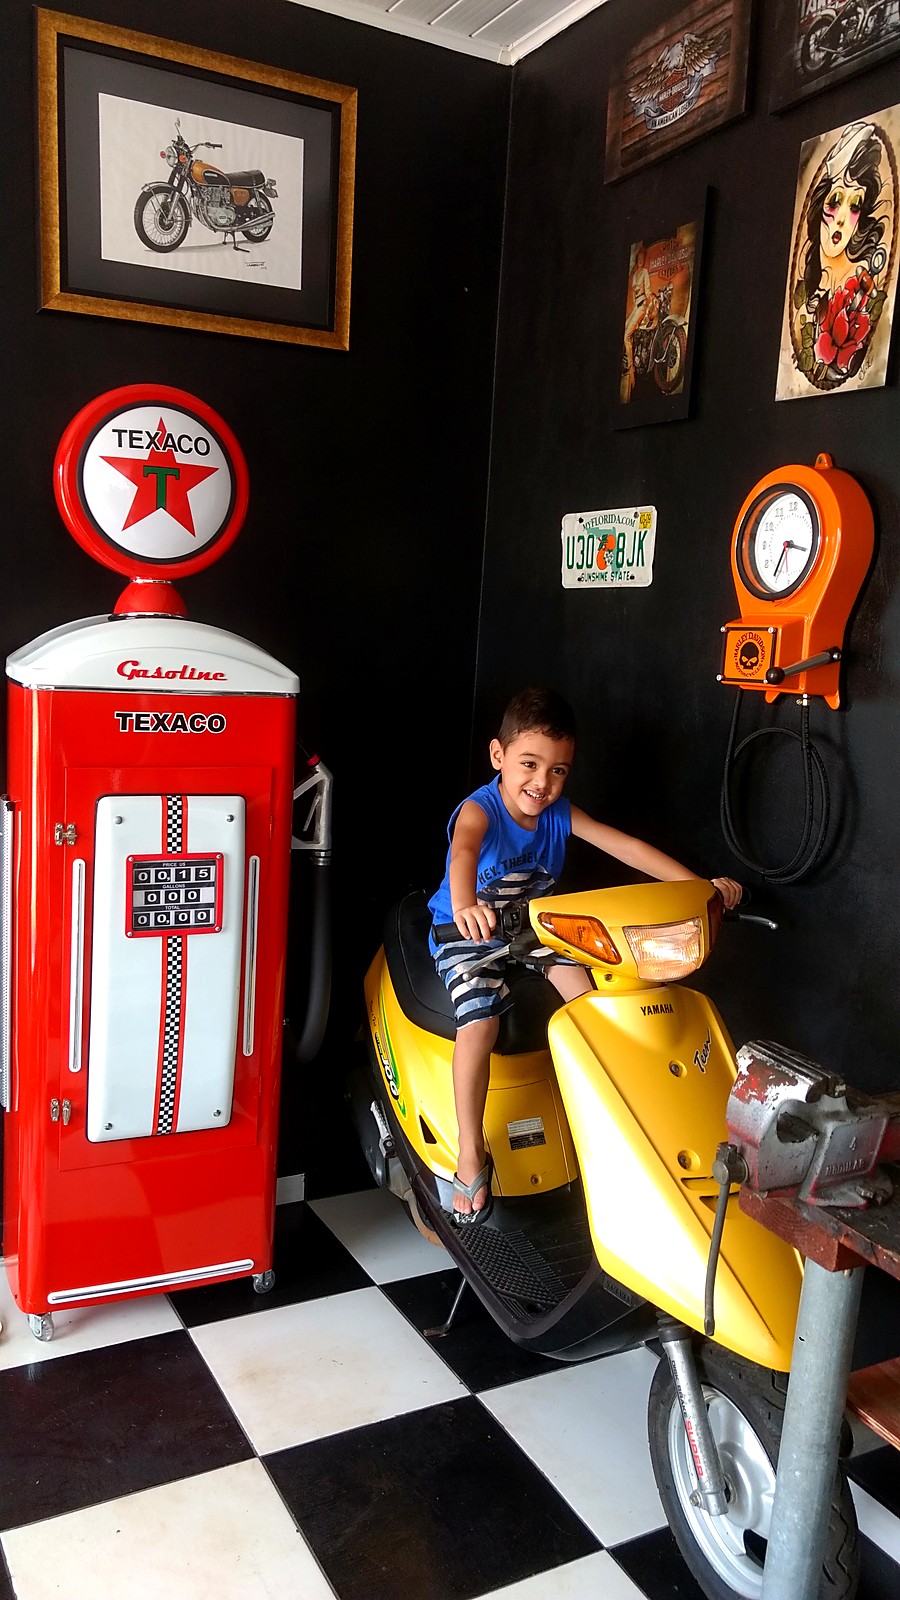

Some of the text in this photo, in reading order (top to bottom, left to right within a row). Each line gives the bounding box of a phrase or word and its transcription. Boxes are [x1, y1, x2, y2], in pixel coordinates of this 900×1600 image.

[111, 428, 211, 457] TEXACO
[143, 466, 181, 510] T
[582, 514, 636, 530] MYFLORIDA.COM
[580, 571, 630, 582] SUNSHINE STATE
[116, 660, 228, 680] Gasoline
[115, 711, 226, 733] TEXACO
[640, 1003, 675, 1016] YAMAHA
[685, 1420, 704, 1477] SUPER
